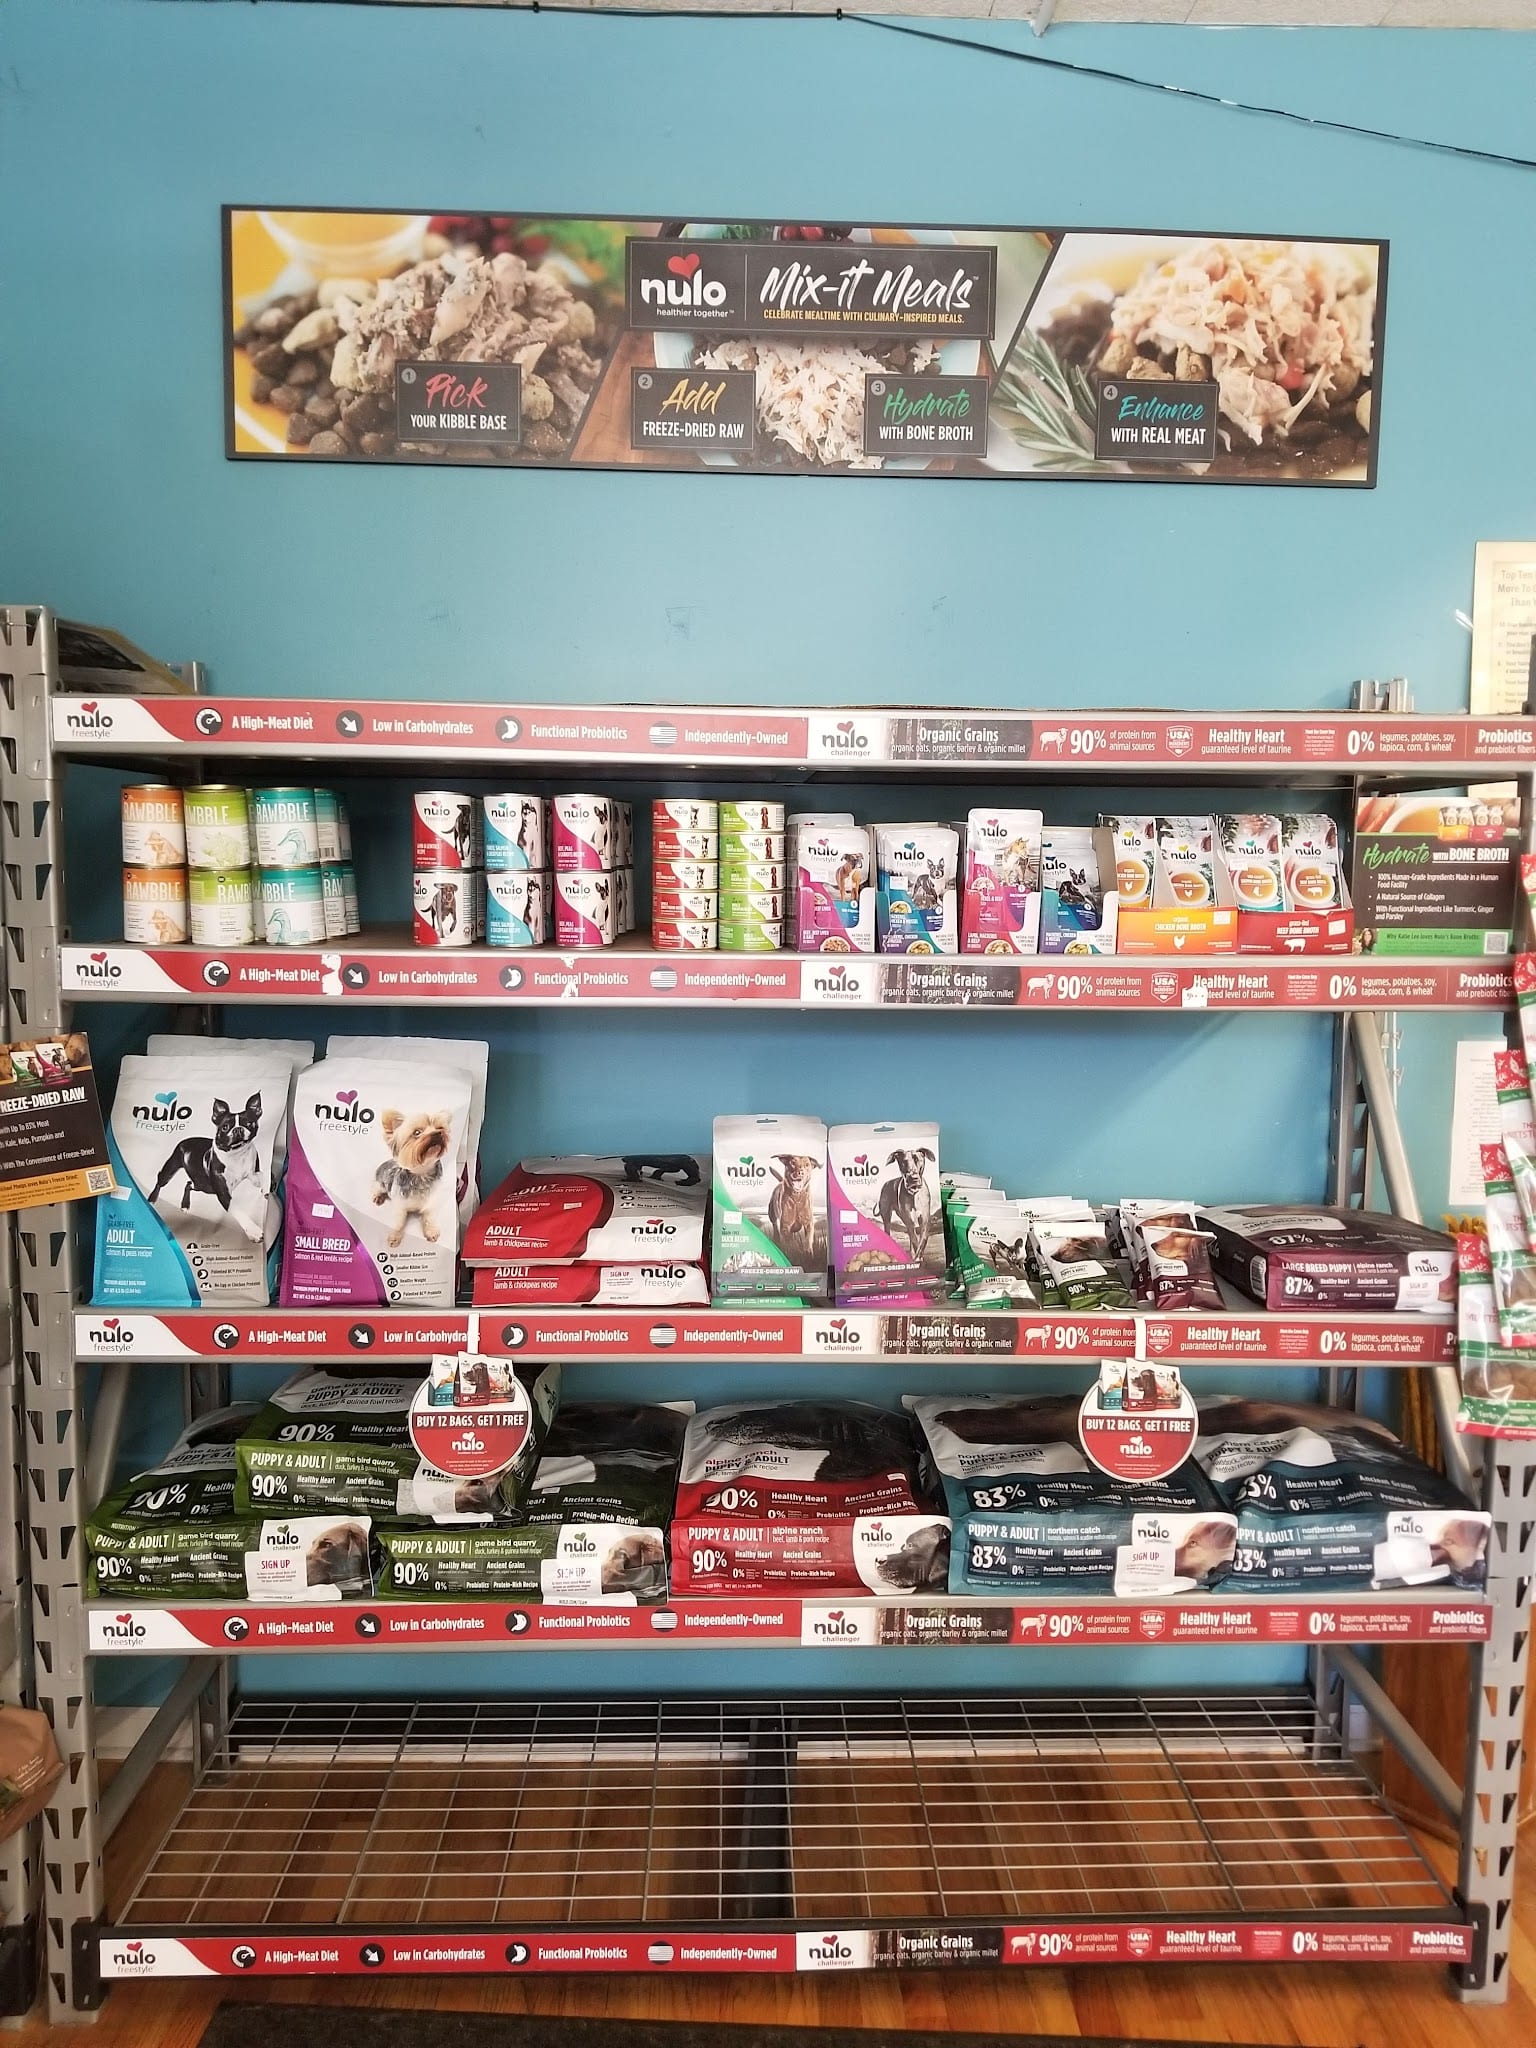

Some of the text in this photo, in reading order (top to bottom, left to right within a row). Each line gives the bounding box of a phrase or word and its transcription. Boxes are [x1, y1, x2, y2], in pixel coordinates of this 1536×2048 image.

[641, 269, 727, 306] nulo
[759, 259, 972, 313] Mix-it Meals
[656, 308, 728, 319] healthier together
[764, 310, 964, 324] CELEBRATE MEALTIME WITH CULINARY-INSPIRED MEALS.
[425, 373, 488, 409] Pick
[660, 379, 727, 416] Add
[882, 388, 971, 426] Hydrate
[1118, 395, 1204, 424] Enhance
[410, 414, 507, 430] YOUR KIBBLE BASE
[643, 422, 745, 439] FREEZE-DRIED RAW
[879, 425, 973, 441] WITH BONE BROTH
[1111, 427, 1206, 445] WITH REAL MEAT
[67, 710, 113, 728] nulo
[232, 716, 313, 731] A High-Meat Diet
[72, 728, 111, 739] freestyle
[373, 719, 474, 736] Low in Carbohydrates
[531, 724, 628, 740] Functional Probiotics
[685, 728, 788, 745] Independently-Owned
[822, 728, 868, 748] nulo
[919, 727, 999, 745] Organic Grains
[1070, 730, 1107, 753] 90%
[1208, 729, 1251, 747] Healthy
[1254, 729, 1285, 743] Heart
[1348, 730, 1375, 754] 0%
[831, 749, 871, 758] challenger
[124, 803, 178, 822] RAWBBLE
[256, 802, 310, 822] RAWBBLE
[424, 807, 450, 817] nulo
[491, 807, 517, 818] nulo
[564, 808, 589, 818] nulo
[808, 843, 839, 857] nulo
[894, 848, 925, 860] nulo
[1239, 845, 1264, 856] nulo
[1295, 845, 1322, 856] nulo
[1363, 843, 1509, 869] Hydrate WITH BONE BROTH
[127, 882, 180, 901] RAWBBLE
[496, 885, 522, 895] nulo
[1096, 976, 1142, 988] of protein from
[1154, 978, 1175, 986] USA
[1361, 977, 1438, 990] legumes, potatoes, soy,
[1095, 987, 1141, 997] animal sources
[1361, 987, 1433, 998] tapioca, corn, & wheat
[0, 1087, 85, 1112] REEZE-DRIED RAW
[132, 1099, 192, 1122] nulo
[315, 1101, 375, 1124] nulo
[135, 1121, 187, 1134] freestyle
[319, 1122, 369, 1136] freestyle
[727, 1162, 766, 1177] nulo
[842, 1161, 879, 1177] nulo
[730, 1178, 764, 1186] freestyle
[846, 1177, 878, 1185] freestyle
[485, 1225, 522, 1235] ADULT
[631, 1221, 677, 1234] nulo
[106, 1229, 135, 1244] ADULT
[295, 1236, 350, 1251] SMALL BREED
[484, 1239, 497, 1247] lamb
[504, 1240, 530, 1248] chickpeas
[315, 1254, 323, 1262] red
[1282, 1262, 1352, 1273] LARGE BREED PUPPY
[1068, 1283, 1085, 1295] 90%
[1285, 1276, 1314, 1295] 87%
[1180, 1341, 1267, 1352] guaranteed level of taurine
[416, 1414, 524, 1428] BUY 12 BAGS, GET 1 FREE
[452, 1438, 485, 1451] nulo
[1120, 1441, 1152, 1455] nulo
[250, 1452, 327, 1469] PUPPY & ADULT
[252, 1474, 288, 1497] 90%
[688, 1527, 823, 1542] PUPPY & ADULT alpine ranch
[968, 1524, 1101, 1540] PUPPY & ADULT northern catch
[692, 1549, 727, 1574] 90%
[972, 1545, 1007, 1568] 83%
[1132, 1552, 1160, 1562] SIGN UP
[262, 1559, 290, 1570] SIGN UP
[900, 1935, 973, 1951] Organic Grains
[1166, 1930, 1236, 1946] Healthy Heart
[1412, 1931, 1464, 1946] Probiotics
[808, 1941, 852, 1959] nulo
